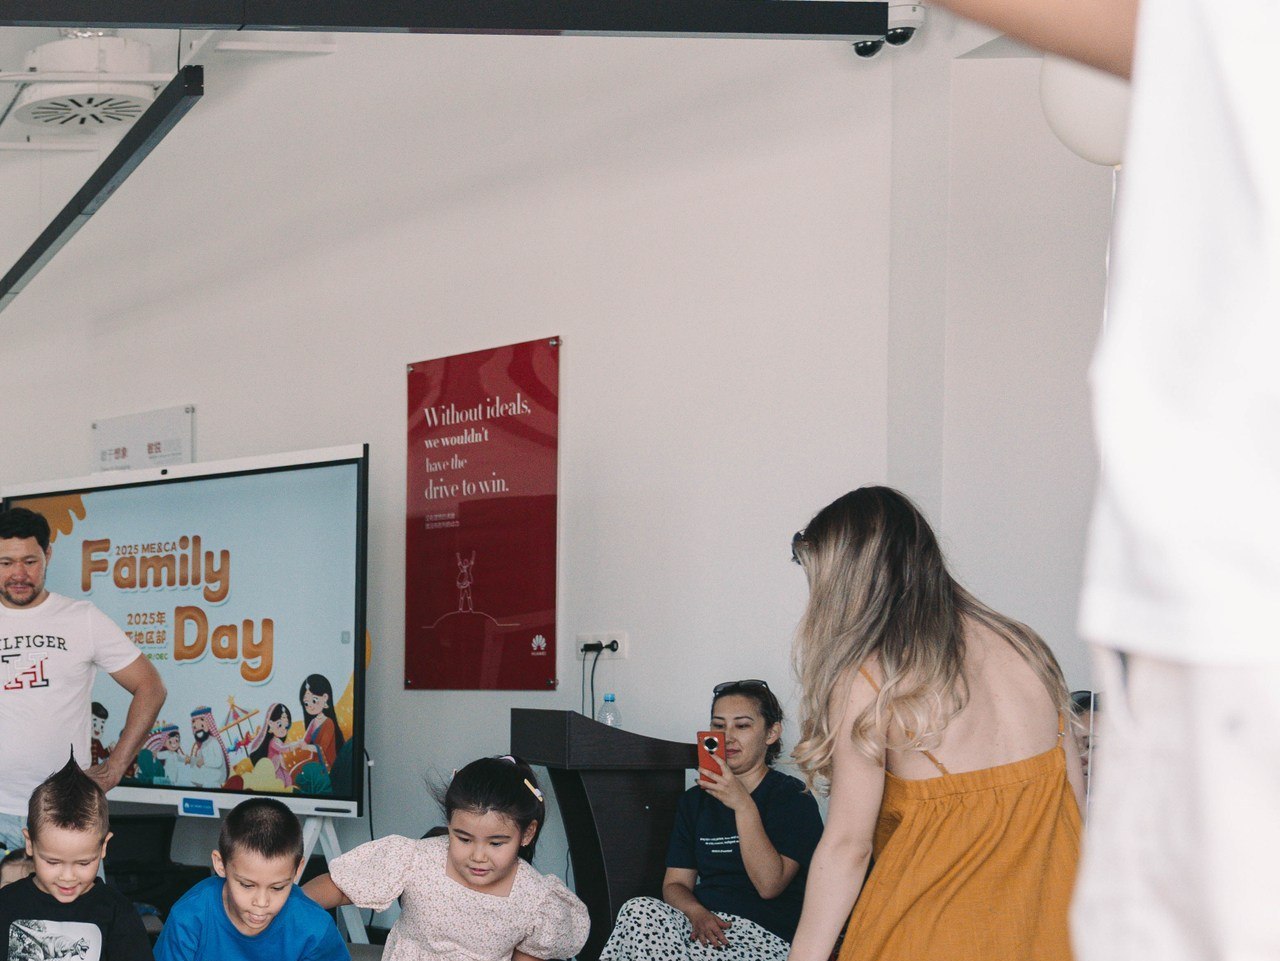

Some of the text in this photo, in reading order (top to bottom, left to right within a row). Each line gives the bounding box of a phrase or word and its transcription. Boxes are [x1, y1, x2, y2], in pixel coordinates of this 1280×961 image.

[424, 403, 482, 427] Without
[424, 427, 488, 449] we wouldn't
[426, 453, 467, 473] have the
[424, 471, 509, 500] drive to win.
[116, 541, 177, 556] 2025 ME&CA
[81, 535, 230, 603] Family
[127, 611, 166, 626] 2025年
[173, 605, 274, 682] Day
